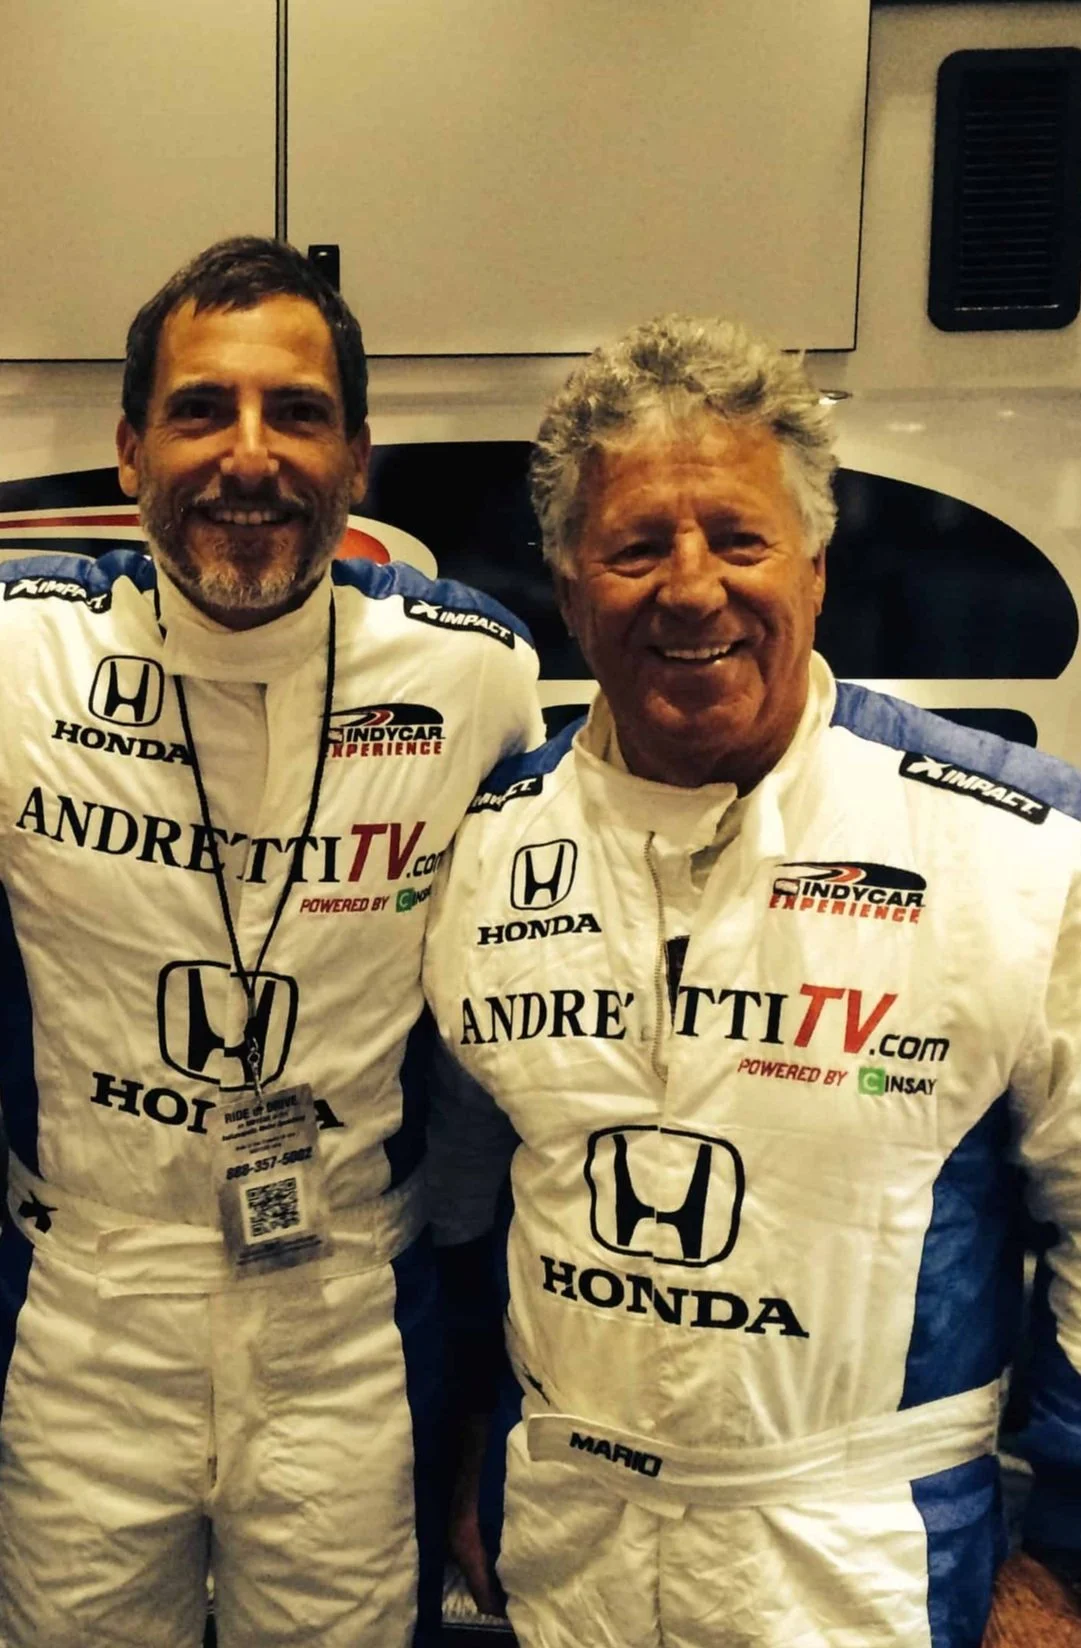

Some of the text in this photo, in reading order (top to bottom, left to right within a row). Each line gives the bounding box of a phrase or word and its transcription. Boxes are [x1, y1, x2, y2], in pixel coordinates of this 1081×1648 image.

[51, 720, 194, 766] HONDA
[346, 726, 442, 742] INDYCAR
[330, 741, 442, 758] XPERIENCE
[300, 898, 368, 913] POWERED
[371, 896, 390, 911] BY
[802, 881, 924, 907] INDYCAR
[769, 894, 921, 924] EXPERIENCE
[477, 913, 602, 945] HONDA
[737, 1058, 820, 1083] POWERED
[823, 1069, 848, 1086] BY
[224, 1108, 250, 1124] RIDE
[540, 1255, 810, 1338] HONDA
[569, 1431, 663, 1477] MARIO
